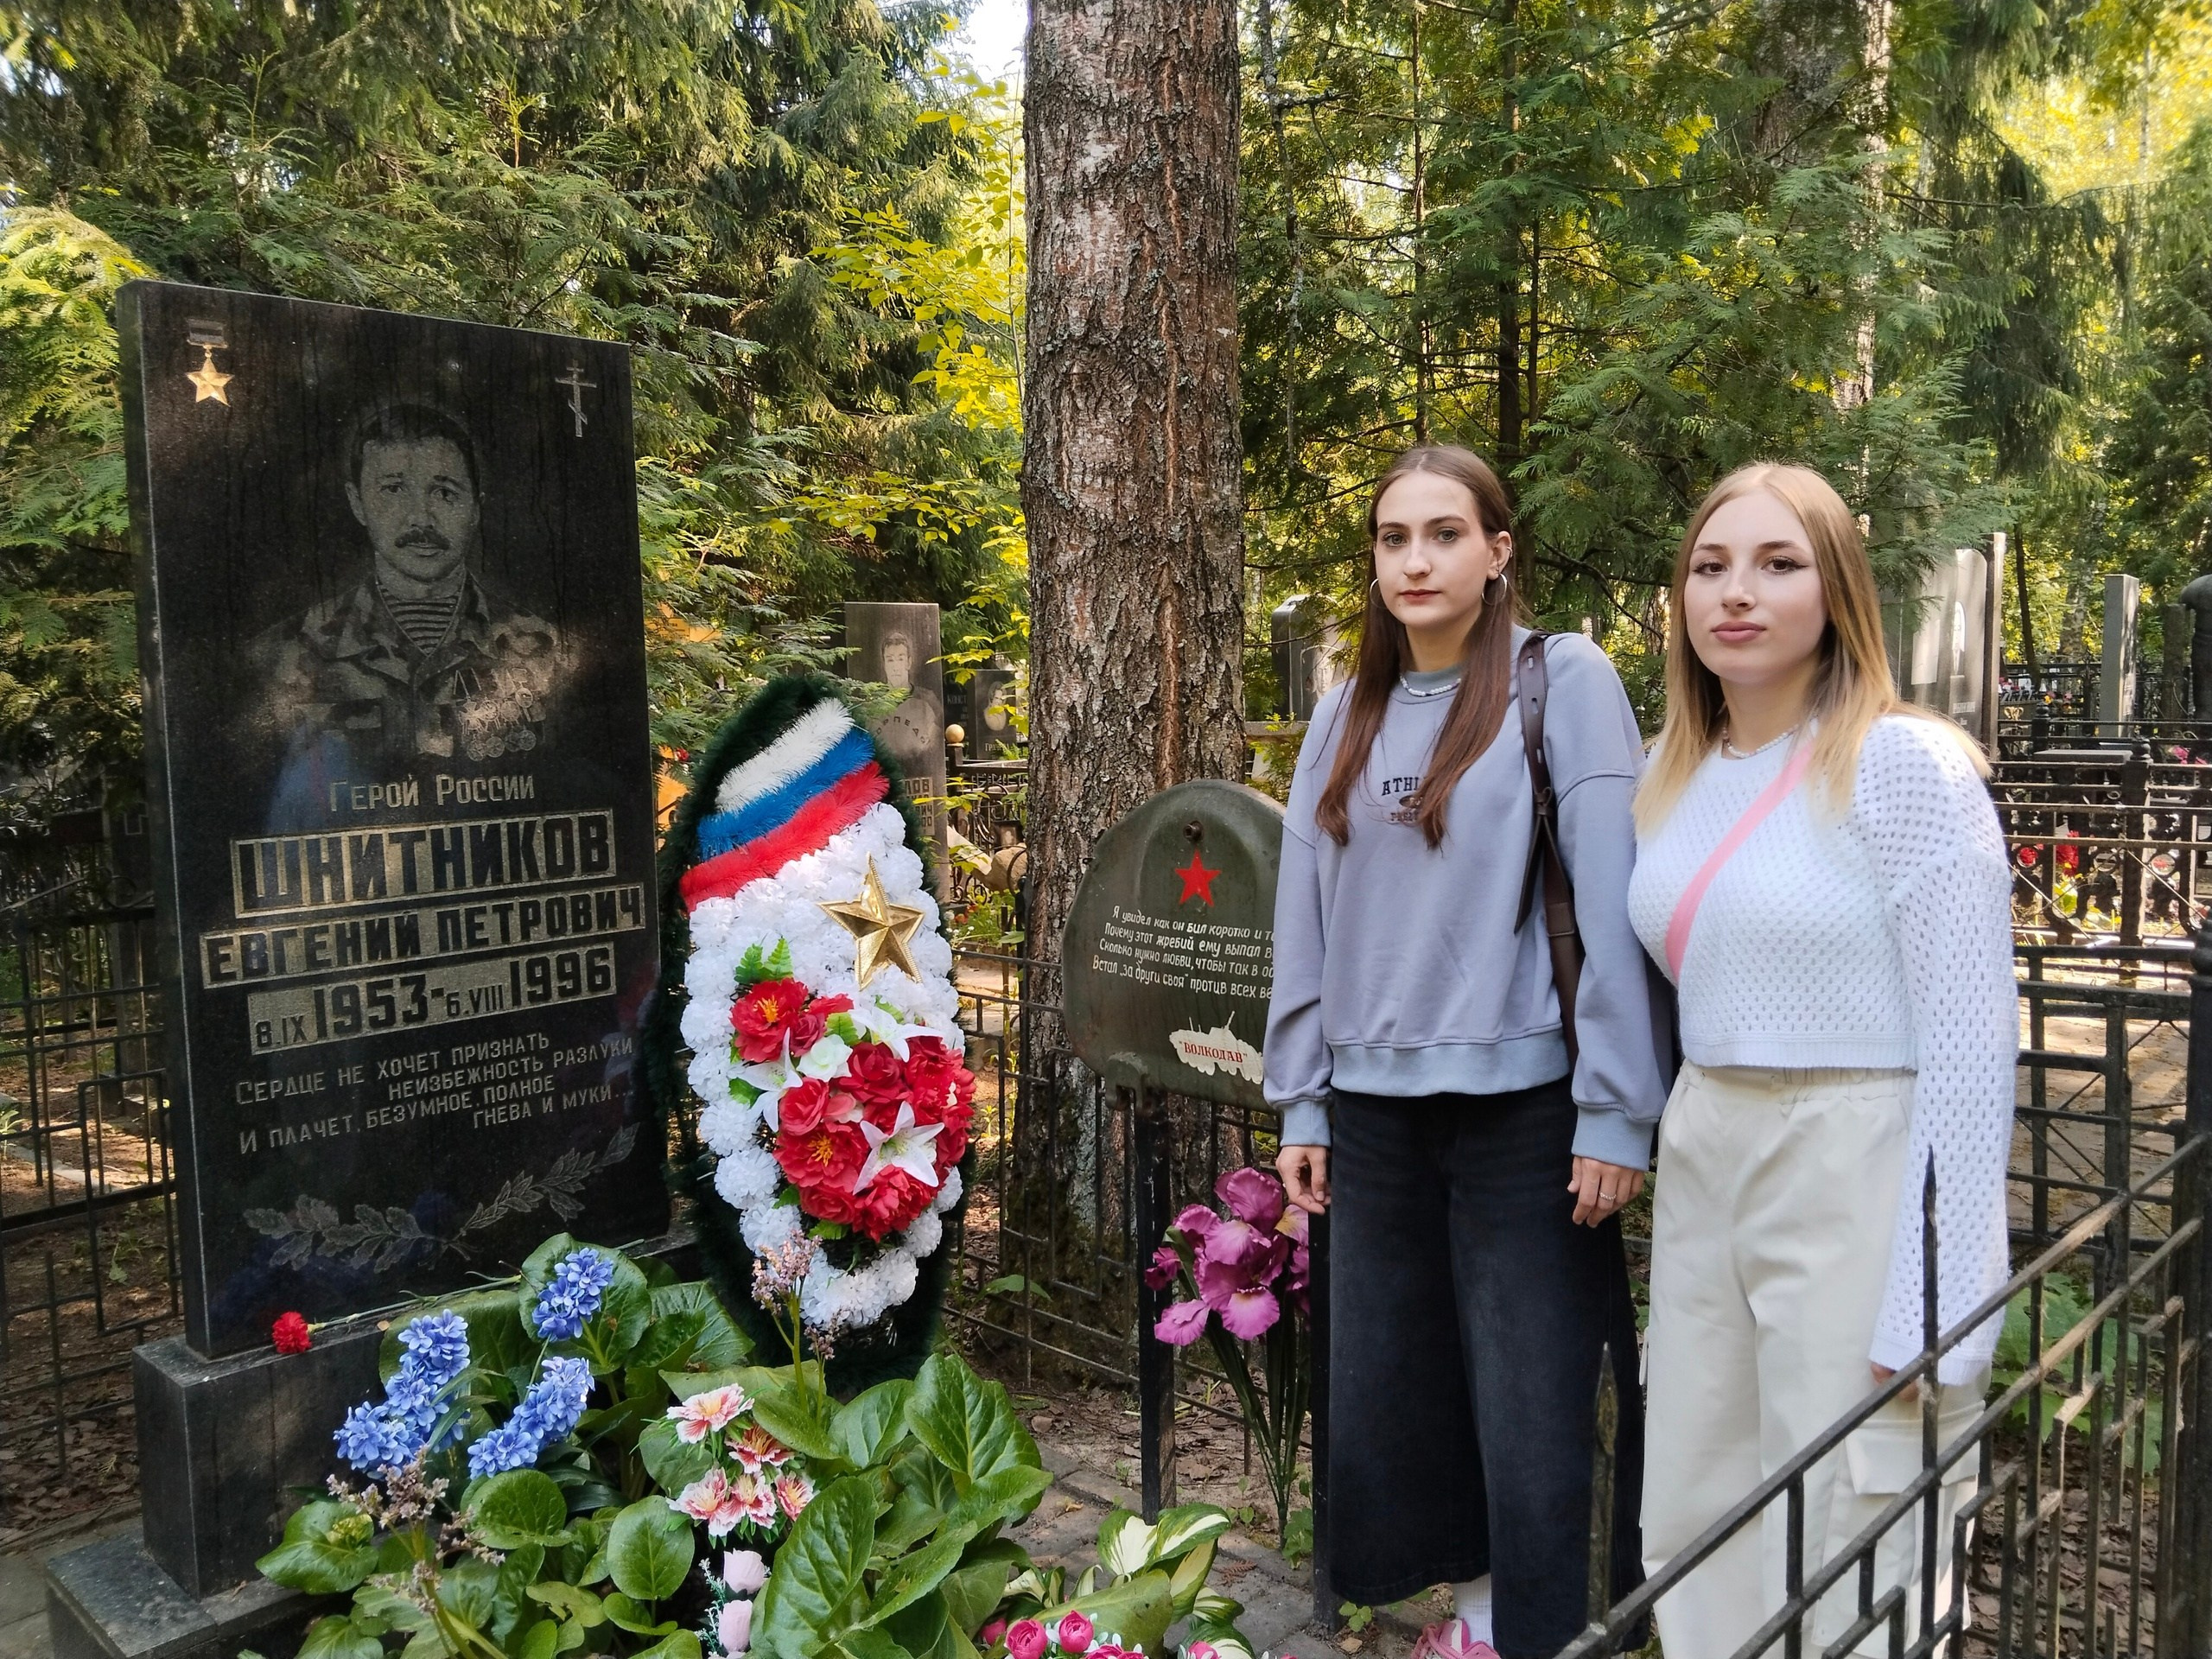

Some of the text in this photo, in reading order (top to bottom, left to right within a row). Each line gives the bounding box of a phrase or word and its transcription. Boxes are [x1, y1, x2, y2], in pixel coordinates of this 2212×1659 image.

[236, 812, 612, 912] ШНИТНИКОВ
[206, 889, 641, 982] ЕВГЕНИЙ ПЕТРОВИЧ
[1104, 922, 1135, 943] Почему
[1135, 931, 1154, 944] этот
[1156, 935, 1194, 950] жребий
[1198, 939, 1221, 957] ему
[1224, 944, 1261, 957] выпал
[1112, 905, 1120, 918] Я
[1122, 909, 1152, 925] увидел
[1154, 918, 1170, 929] как
[1173, 920, 1185, 931] он
[1209, 925, 1250, 938] коротко
[1254, 929, 1262, 939] и
[510, 947, 612, 1007] 1996
[1092, 955, 1117, 974] Встал
[1135, 961, 1160, 985] други
[1190, 978, 1227, 995] против
[1230, 983, 1256, 998] всех
[1099, 938, 1133, 957] Сколько
[1135, 947, 1160, 964] нужно
[1162, 952, 1194, 970] любви,
[1195, 957, 1226, 972] чтобы
[1229, 962, 1249, 975] так
[1251, 964, 1258, 976] в
[338, 1065, 365, 1087] НЕ
[378, 1051, 441, 1080] ХОЧЕТ
[452, 1033, 550, 1065] ПРИЗНАТЬ
[389, 1038, 633, 1101] НЕИЗБЕЖНОСТЬ РАЗЛУКИ
[239, 1129, 257, 1154] И
[483, 1074, 555, 1104] ПОЛНОЕ
[474, 1101, 532, 1128] ГНЕВА
[542, 1096, 554, 1114] И
